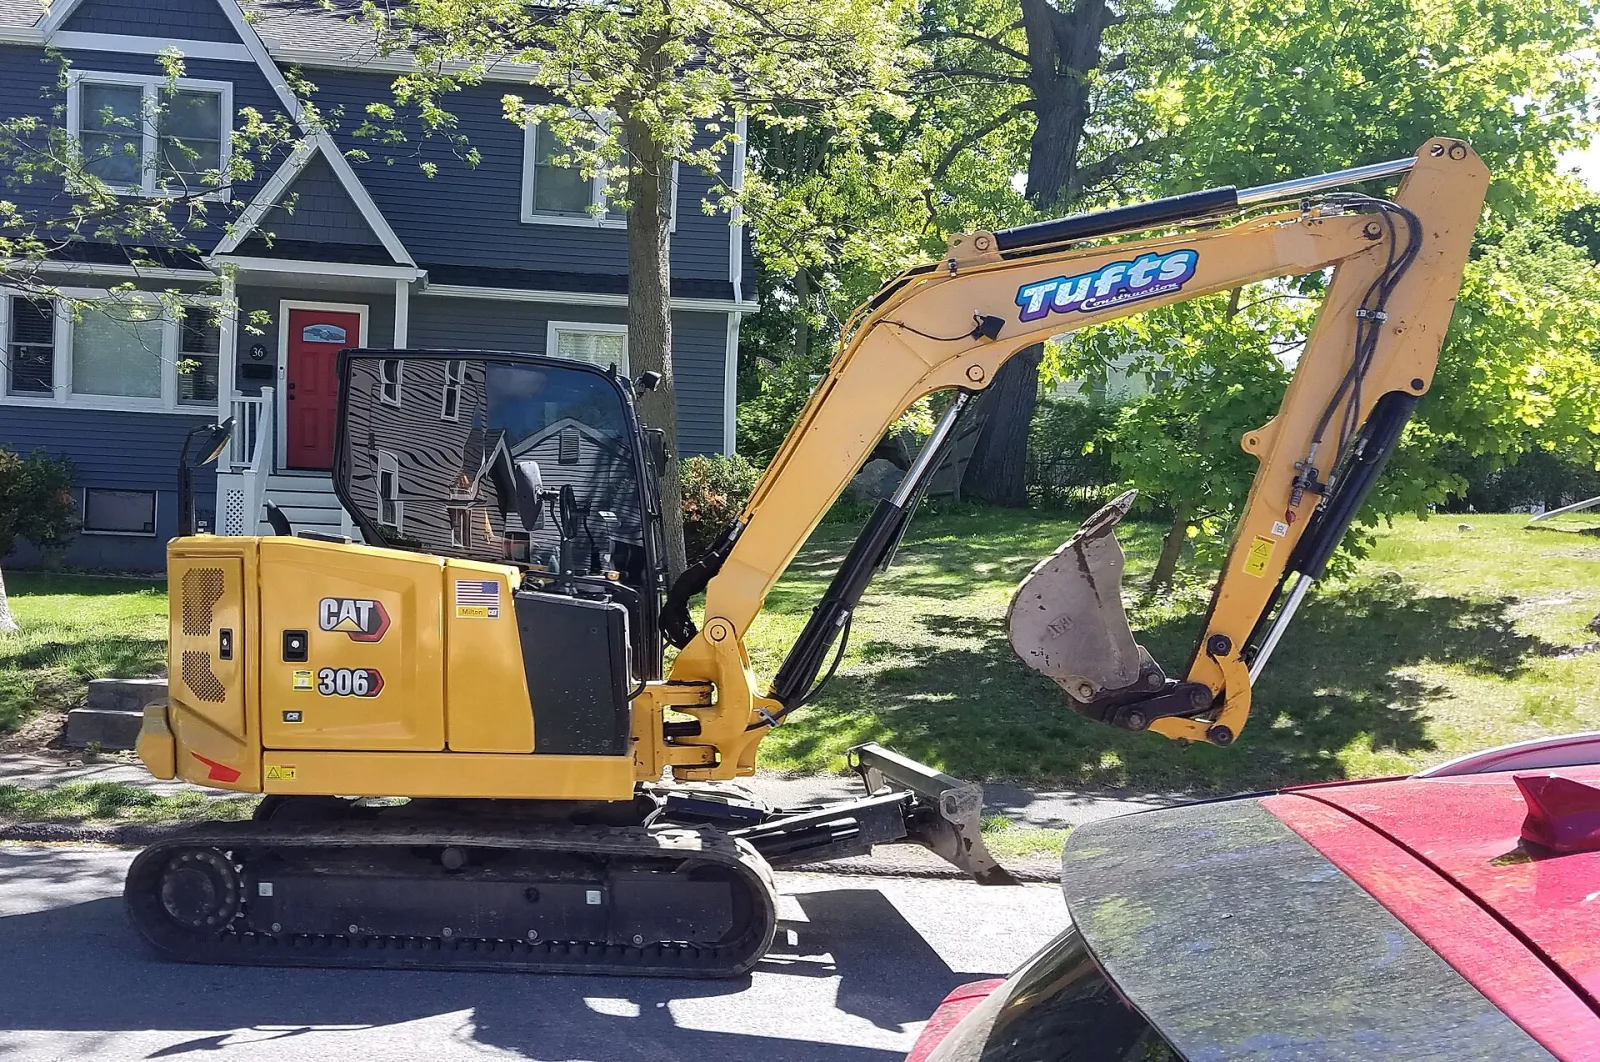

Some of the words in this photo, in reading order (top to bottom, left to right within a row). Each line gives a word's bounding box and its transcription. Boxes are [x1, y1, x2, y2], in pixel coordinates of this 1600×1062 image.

[1023, 253, 1190, 314] Tufts
[1080, 282, 1180, 312] Construction
[252, 347, 264, 358] 36
[320, 598, 374, 633] CAT
[319, 668, 369, 696] 306
